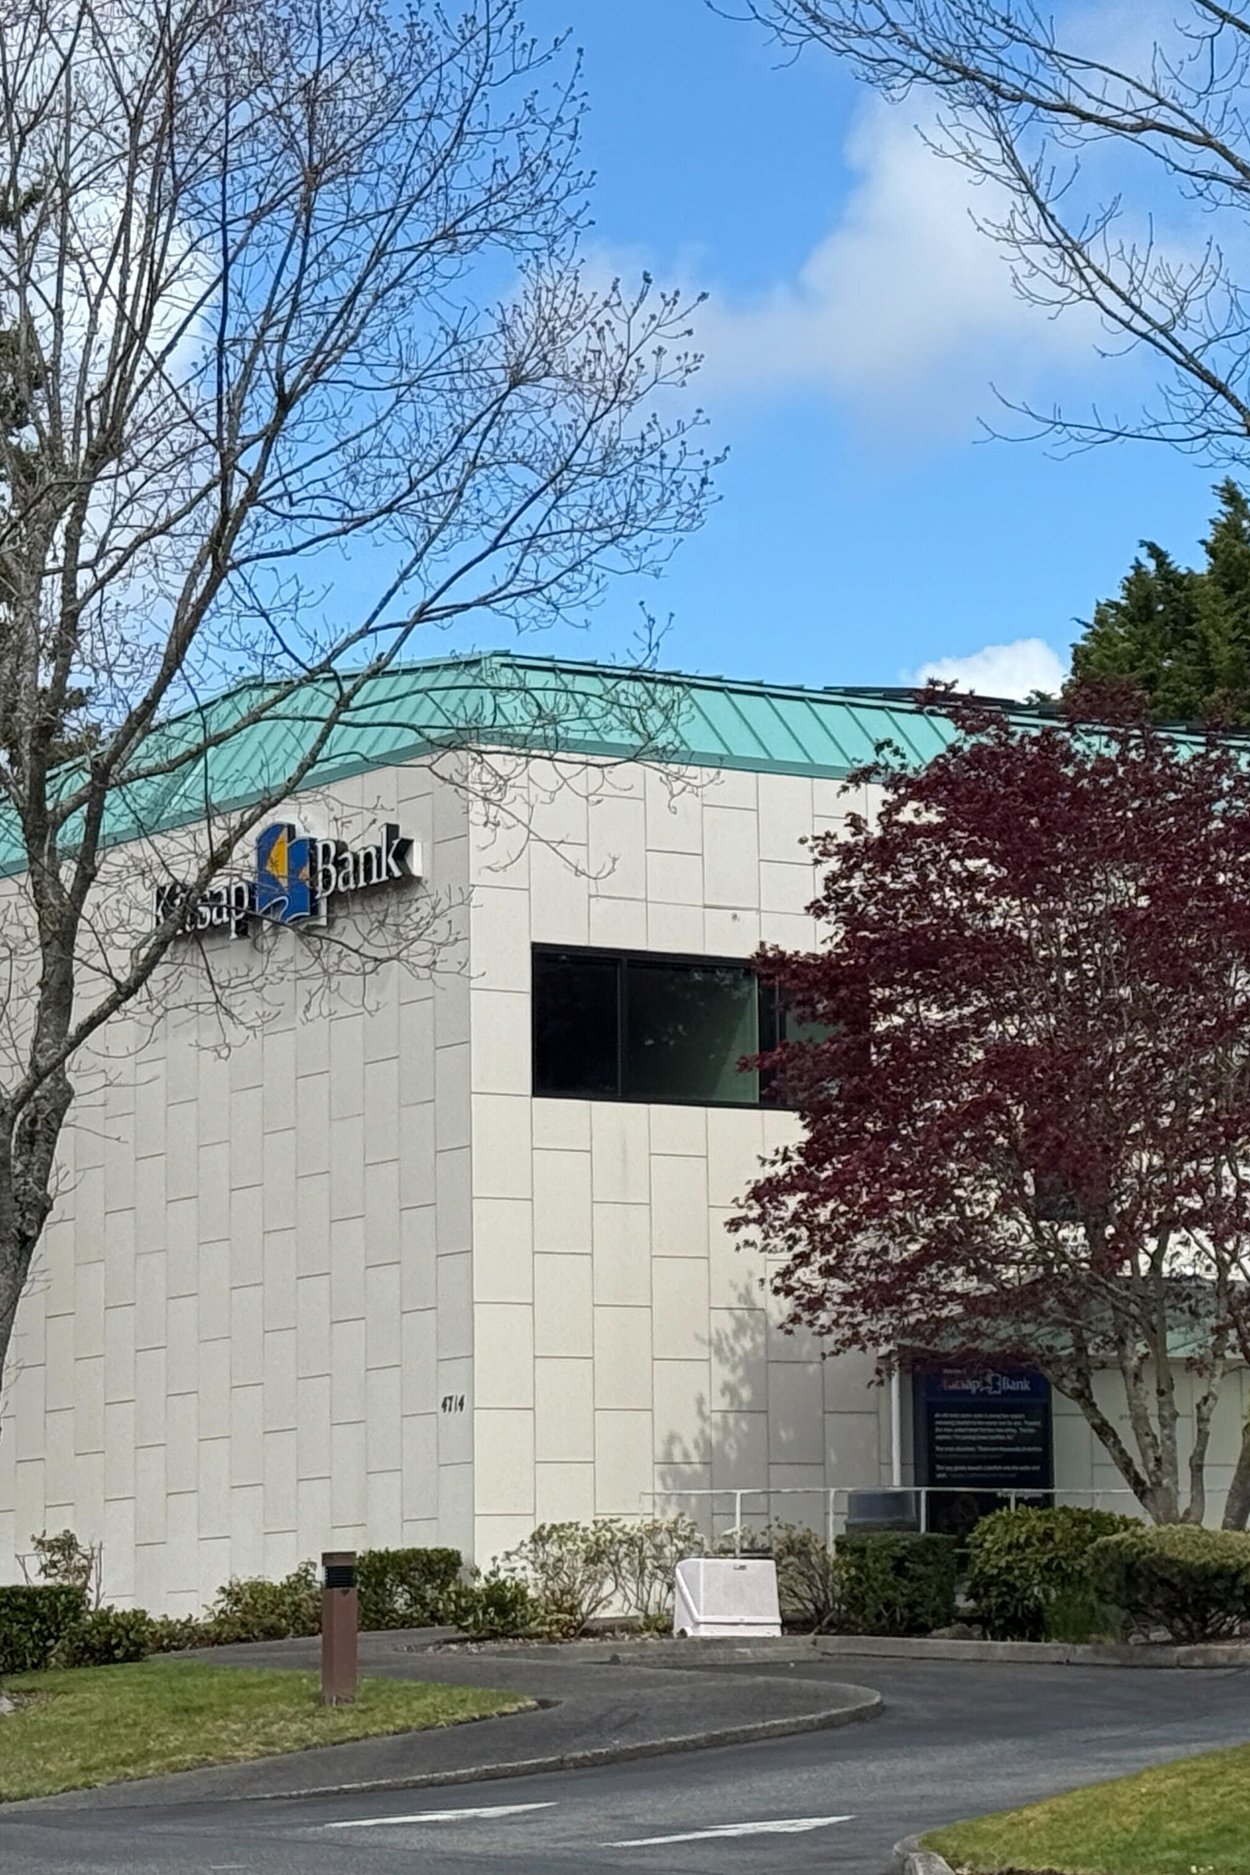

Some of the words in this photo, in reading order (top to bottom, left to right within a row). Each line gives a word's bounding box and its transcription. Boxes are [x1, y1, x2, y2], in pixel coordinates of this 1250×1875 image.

[152, 881, 249, 940] Ksap
[315, 823, 406, 899] Bank
[1002, 1375, 1031, 1391] Bank
[441, 1391, 465, 1414] 4714
